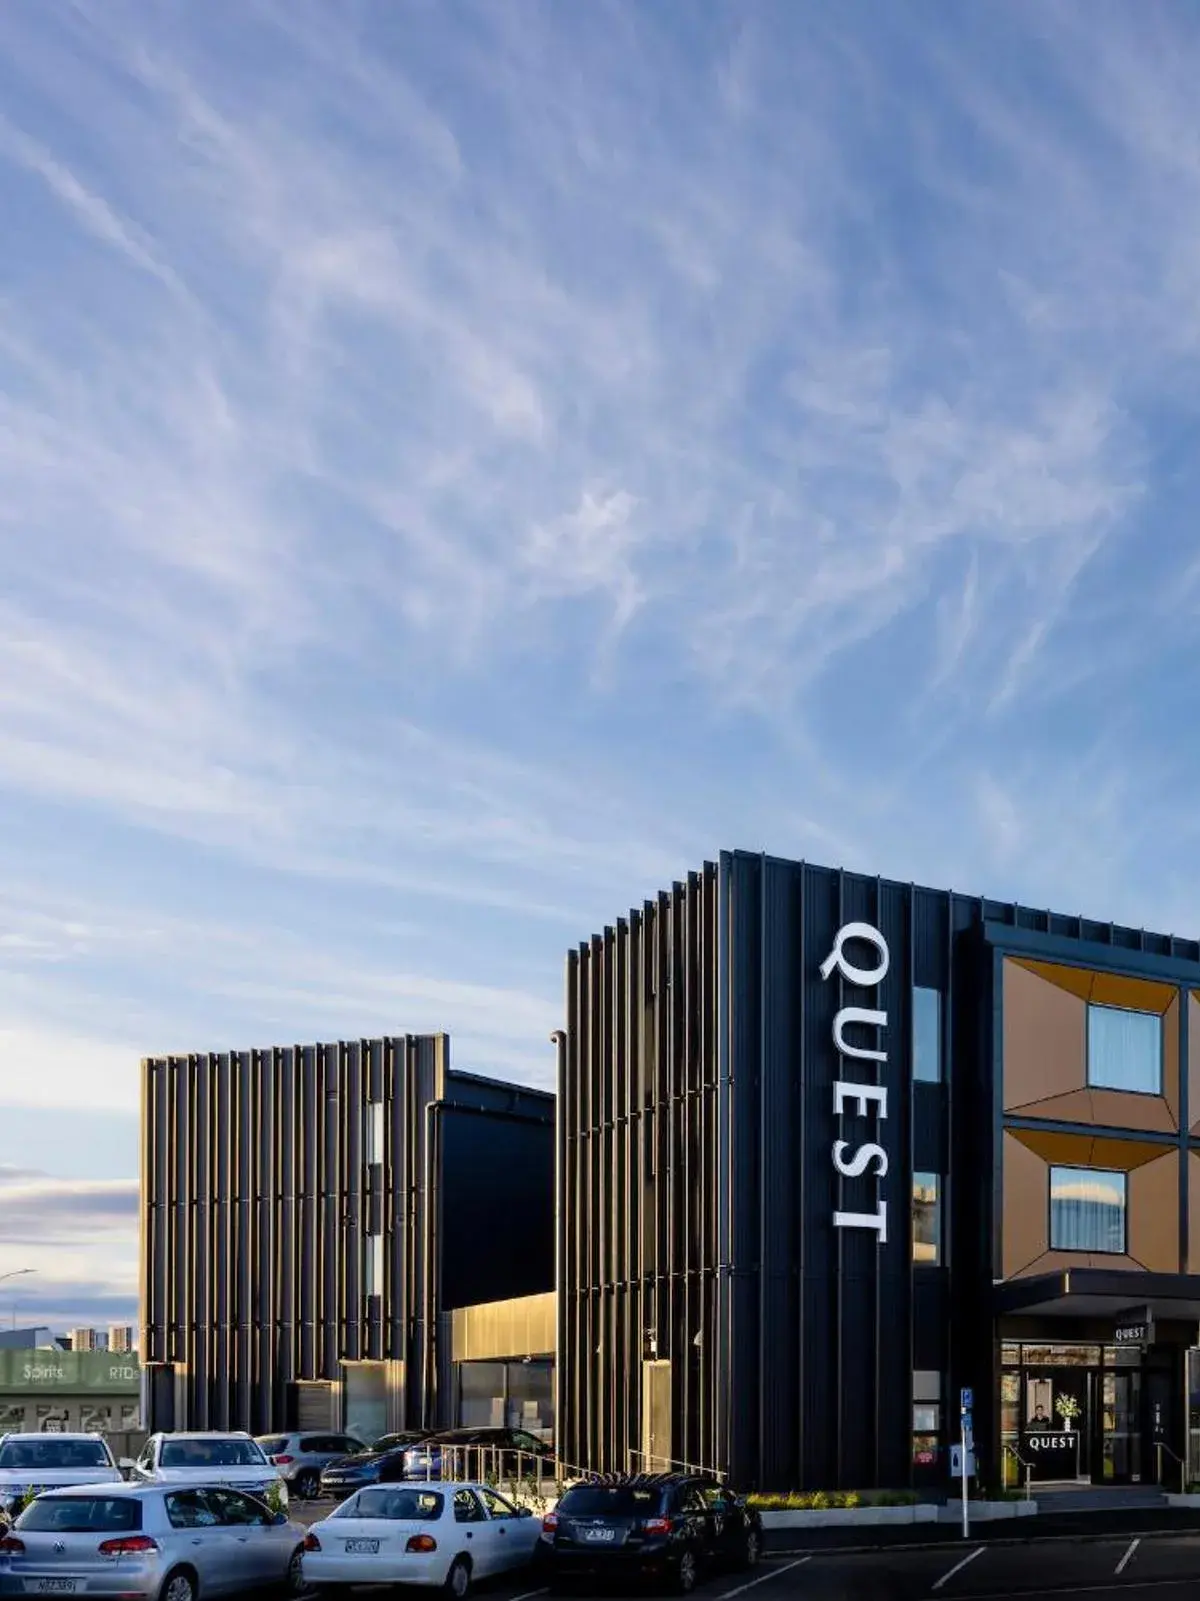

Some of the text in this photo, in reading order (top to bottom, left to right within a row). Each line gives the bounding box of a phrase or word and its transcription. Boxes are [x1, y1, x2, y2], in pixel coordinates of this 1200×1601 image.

[819, 922, 890, 1243] QUEST
[1115, 1326, 1145, 1341] QUEST
[23, 1364, 64, 1381] Spirits
[1029, 1437, 1075, 1451] QUEST
